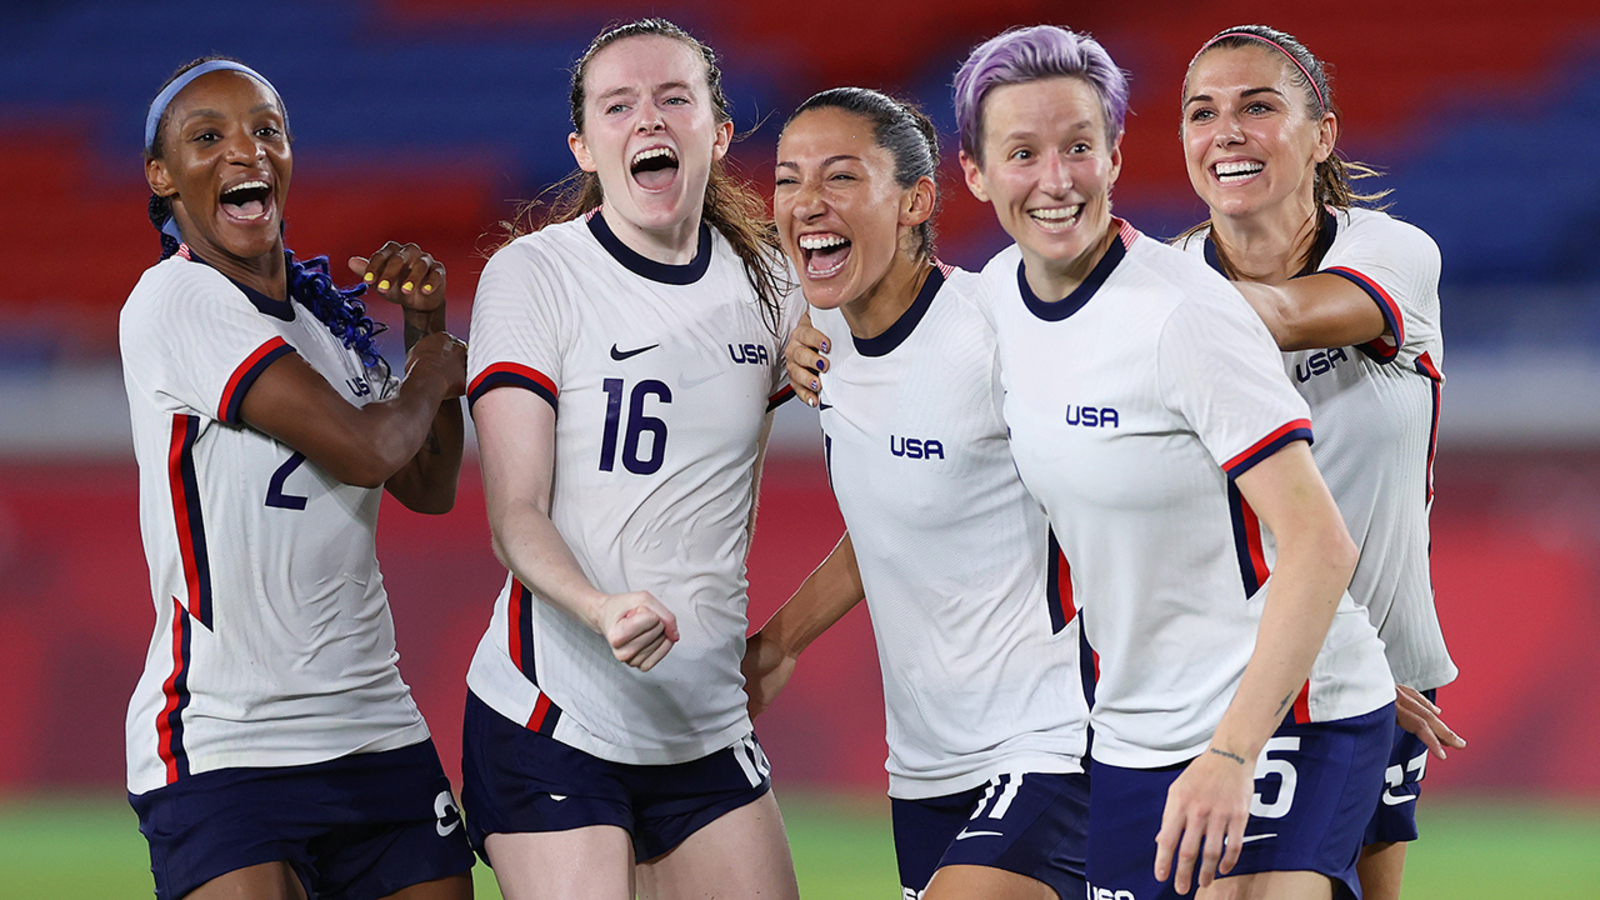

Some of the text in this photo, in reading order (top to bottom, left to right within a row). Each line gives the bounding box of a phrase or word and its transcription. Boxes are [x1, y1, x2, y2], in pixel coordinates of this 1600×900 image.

[727, 344, 769, 366] USA
[1296, 347, 1348, 383] USA
[345, 373, 371, 397] US
[599, 378, 672, 475] 16
[1066, 404, 1119, 428] USA
[890, 434, 944, 460] USA
[264, 451, 308, 511] 2
[1248, 737, 1300, 819] 5
[970, 773, 1022, 820] 11
